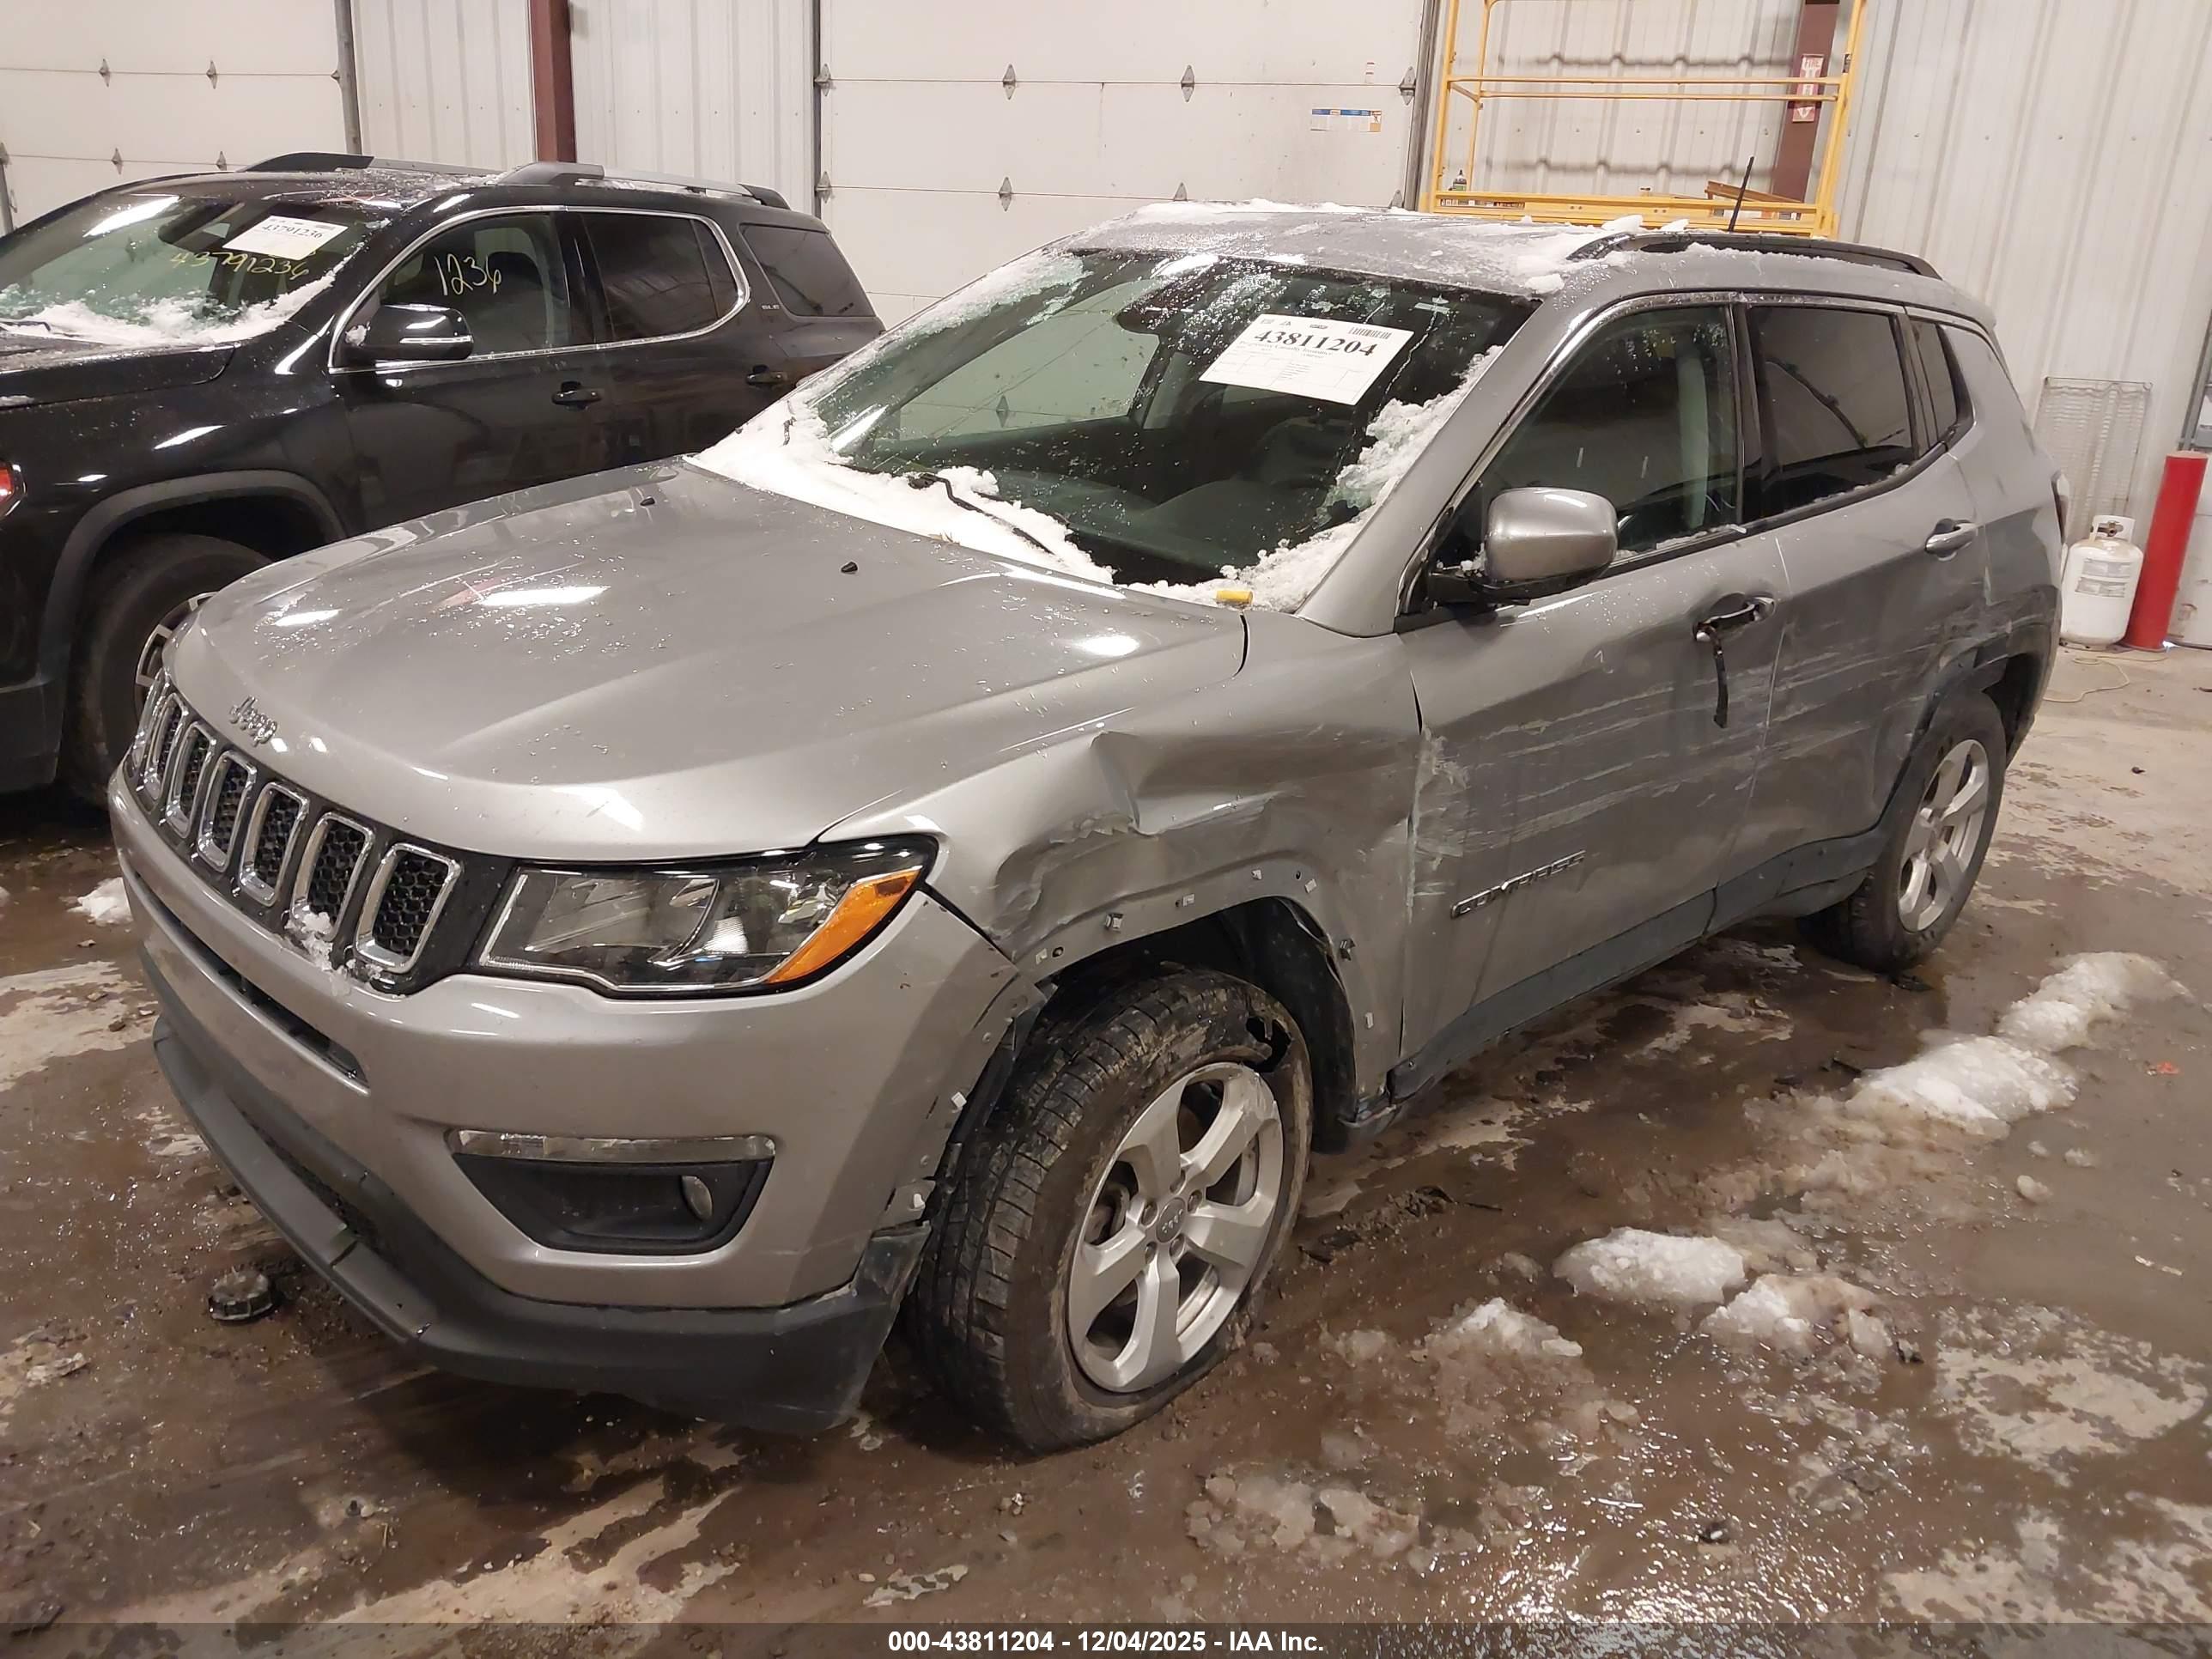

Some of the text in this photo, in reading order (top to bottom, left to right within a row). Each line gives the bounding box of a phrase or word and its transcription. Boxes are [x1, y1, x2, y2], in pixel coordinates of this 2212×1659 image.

[261, 223, 323, 240] 43791236
[170, 251, 310, 281] 43791236
[433, 253, 502, 296] 1236
[1254, 329, 1378, 356] 43811204
[228, 696, 278, 748] Jeep
